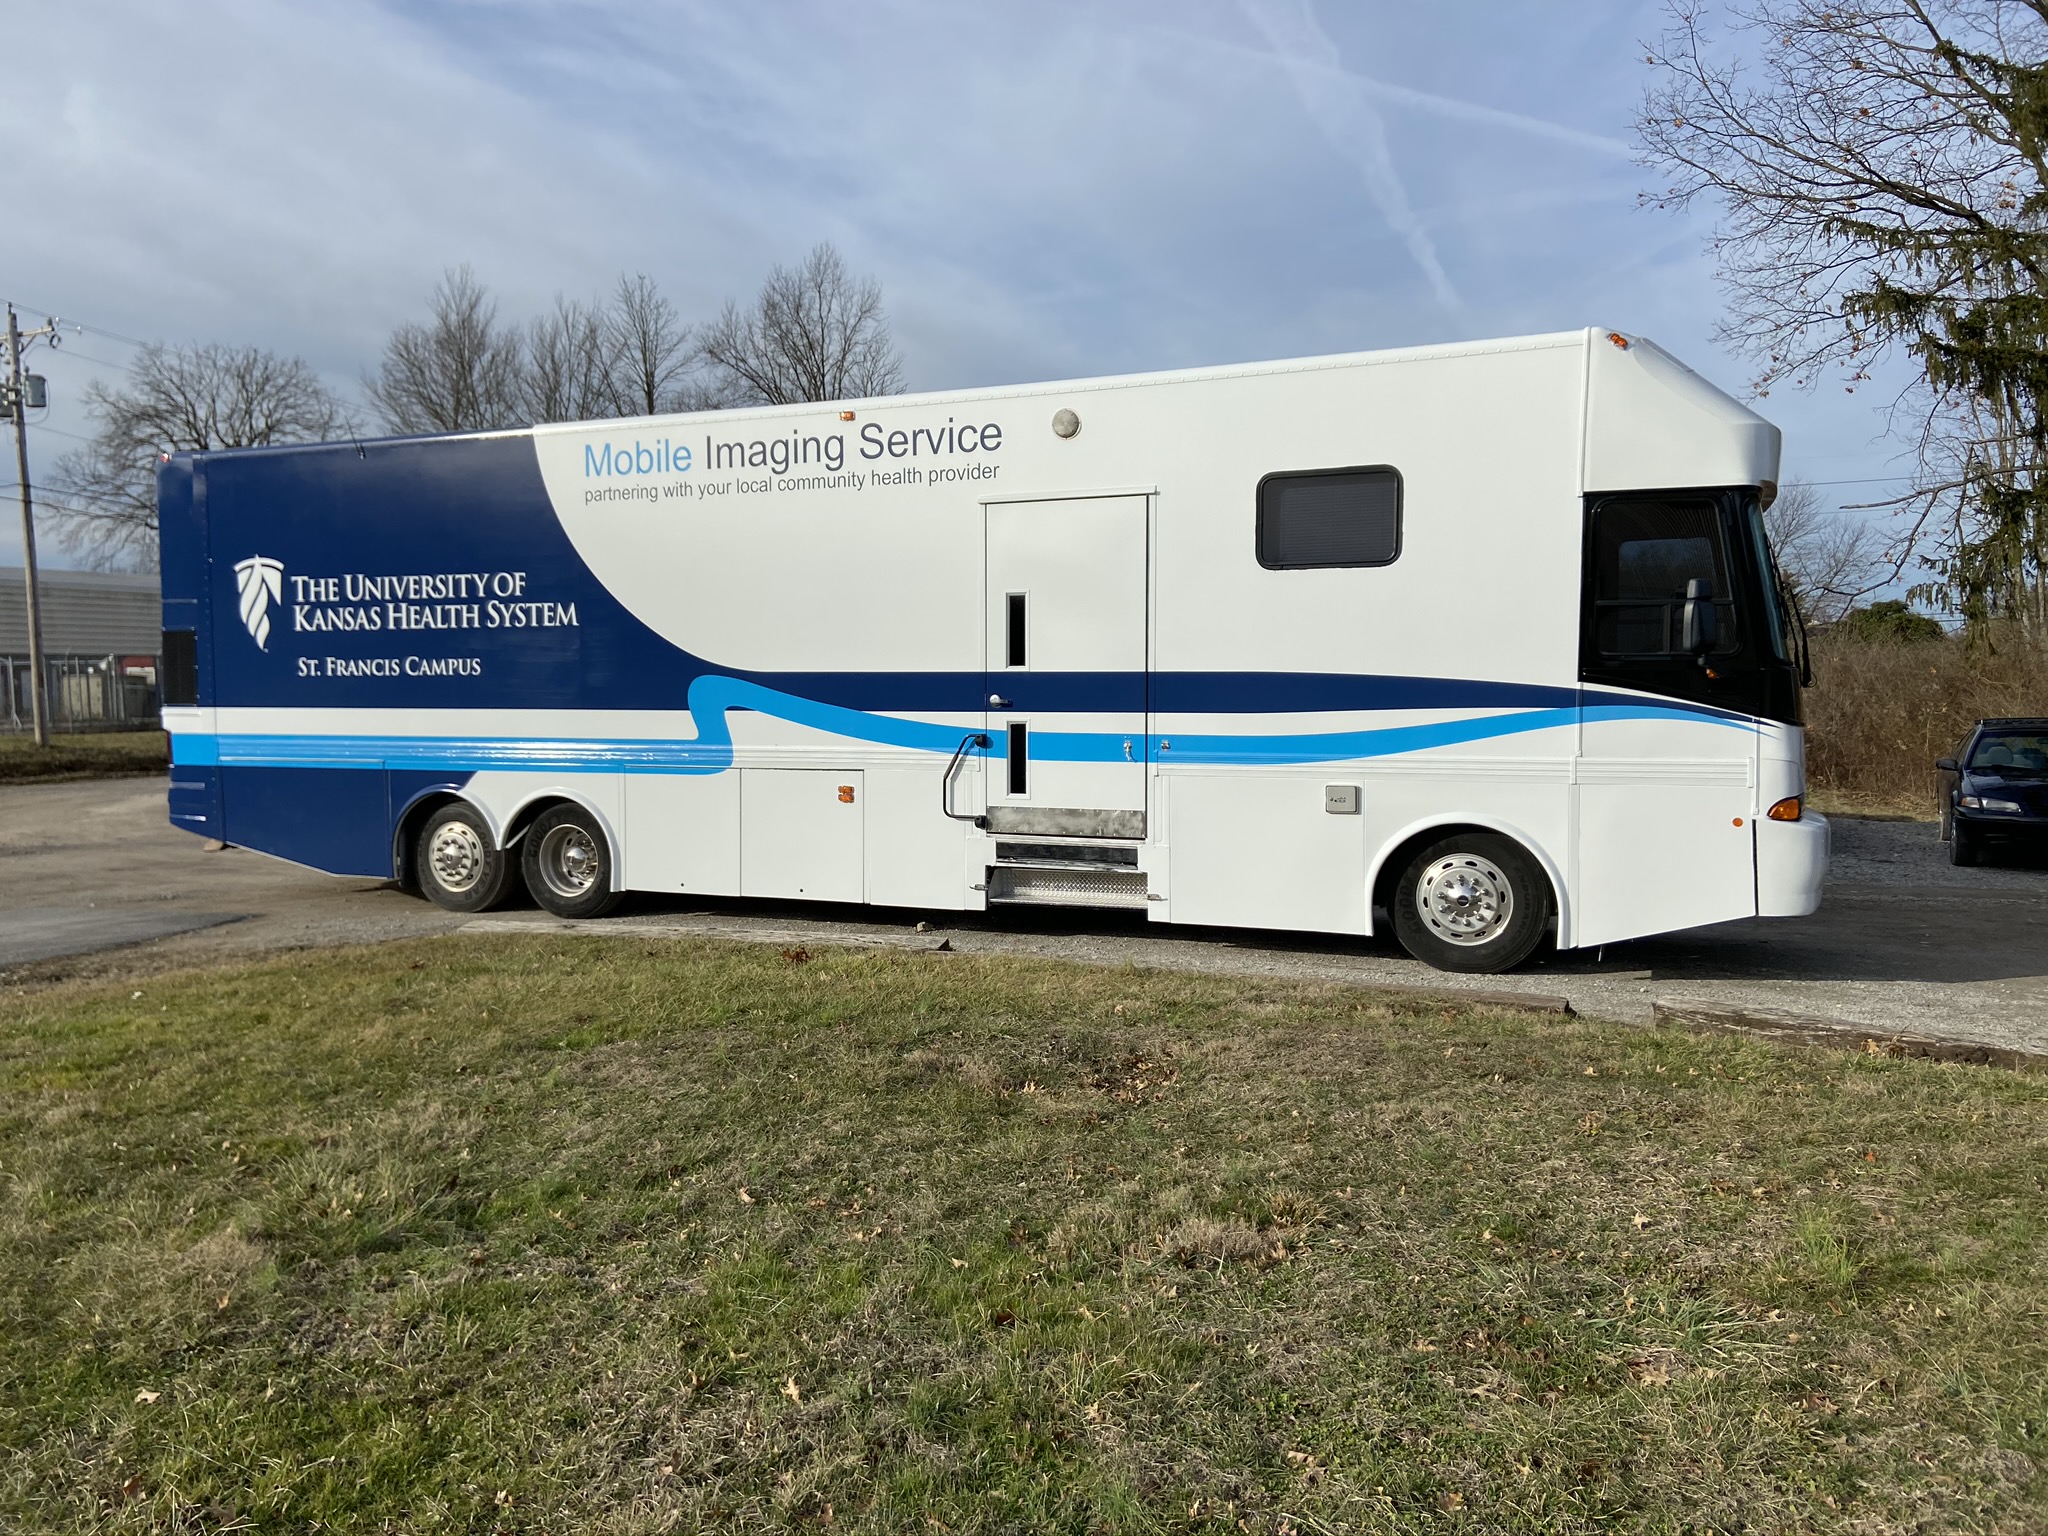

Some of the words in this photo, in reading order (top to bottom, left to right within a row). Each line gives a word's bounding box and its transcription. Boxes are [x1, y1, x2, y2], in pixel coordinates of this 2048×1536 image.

[585, 438, 692, 477] Mobile
[706, 429, 844, 475] Imaging
[860, 417, 1003, 460] Service
[585, 484, 658, 506] partnering
[663, 481, 693, 498] with
[698, 482, 732, 500] your
[736, 476, 772, 494] local
[777, 471, 866, 492] community
[871, 467, 922, 486] health
[929, 462, 1000, 487] provider
[290, 575, 340, 602] THE
[343, 573, 490, 602] UNIVERSITY
[493, 571, 527, 597] OF
[293, 604, 381, 632] KANSAS
[386, 602, 481, 630] HEALTH
[487, 600, 580, 628] SYSTEM
[298, 656, 321, 677] ST.
[325, 656, 400, 677] FRANCIS
[405, 656, 482, 676] CAMPUS
